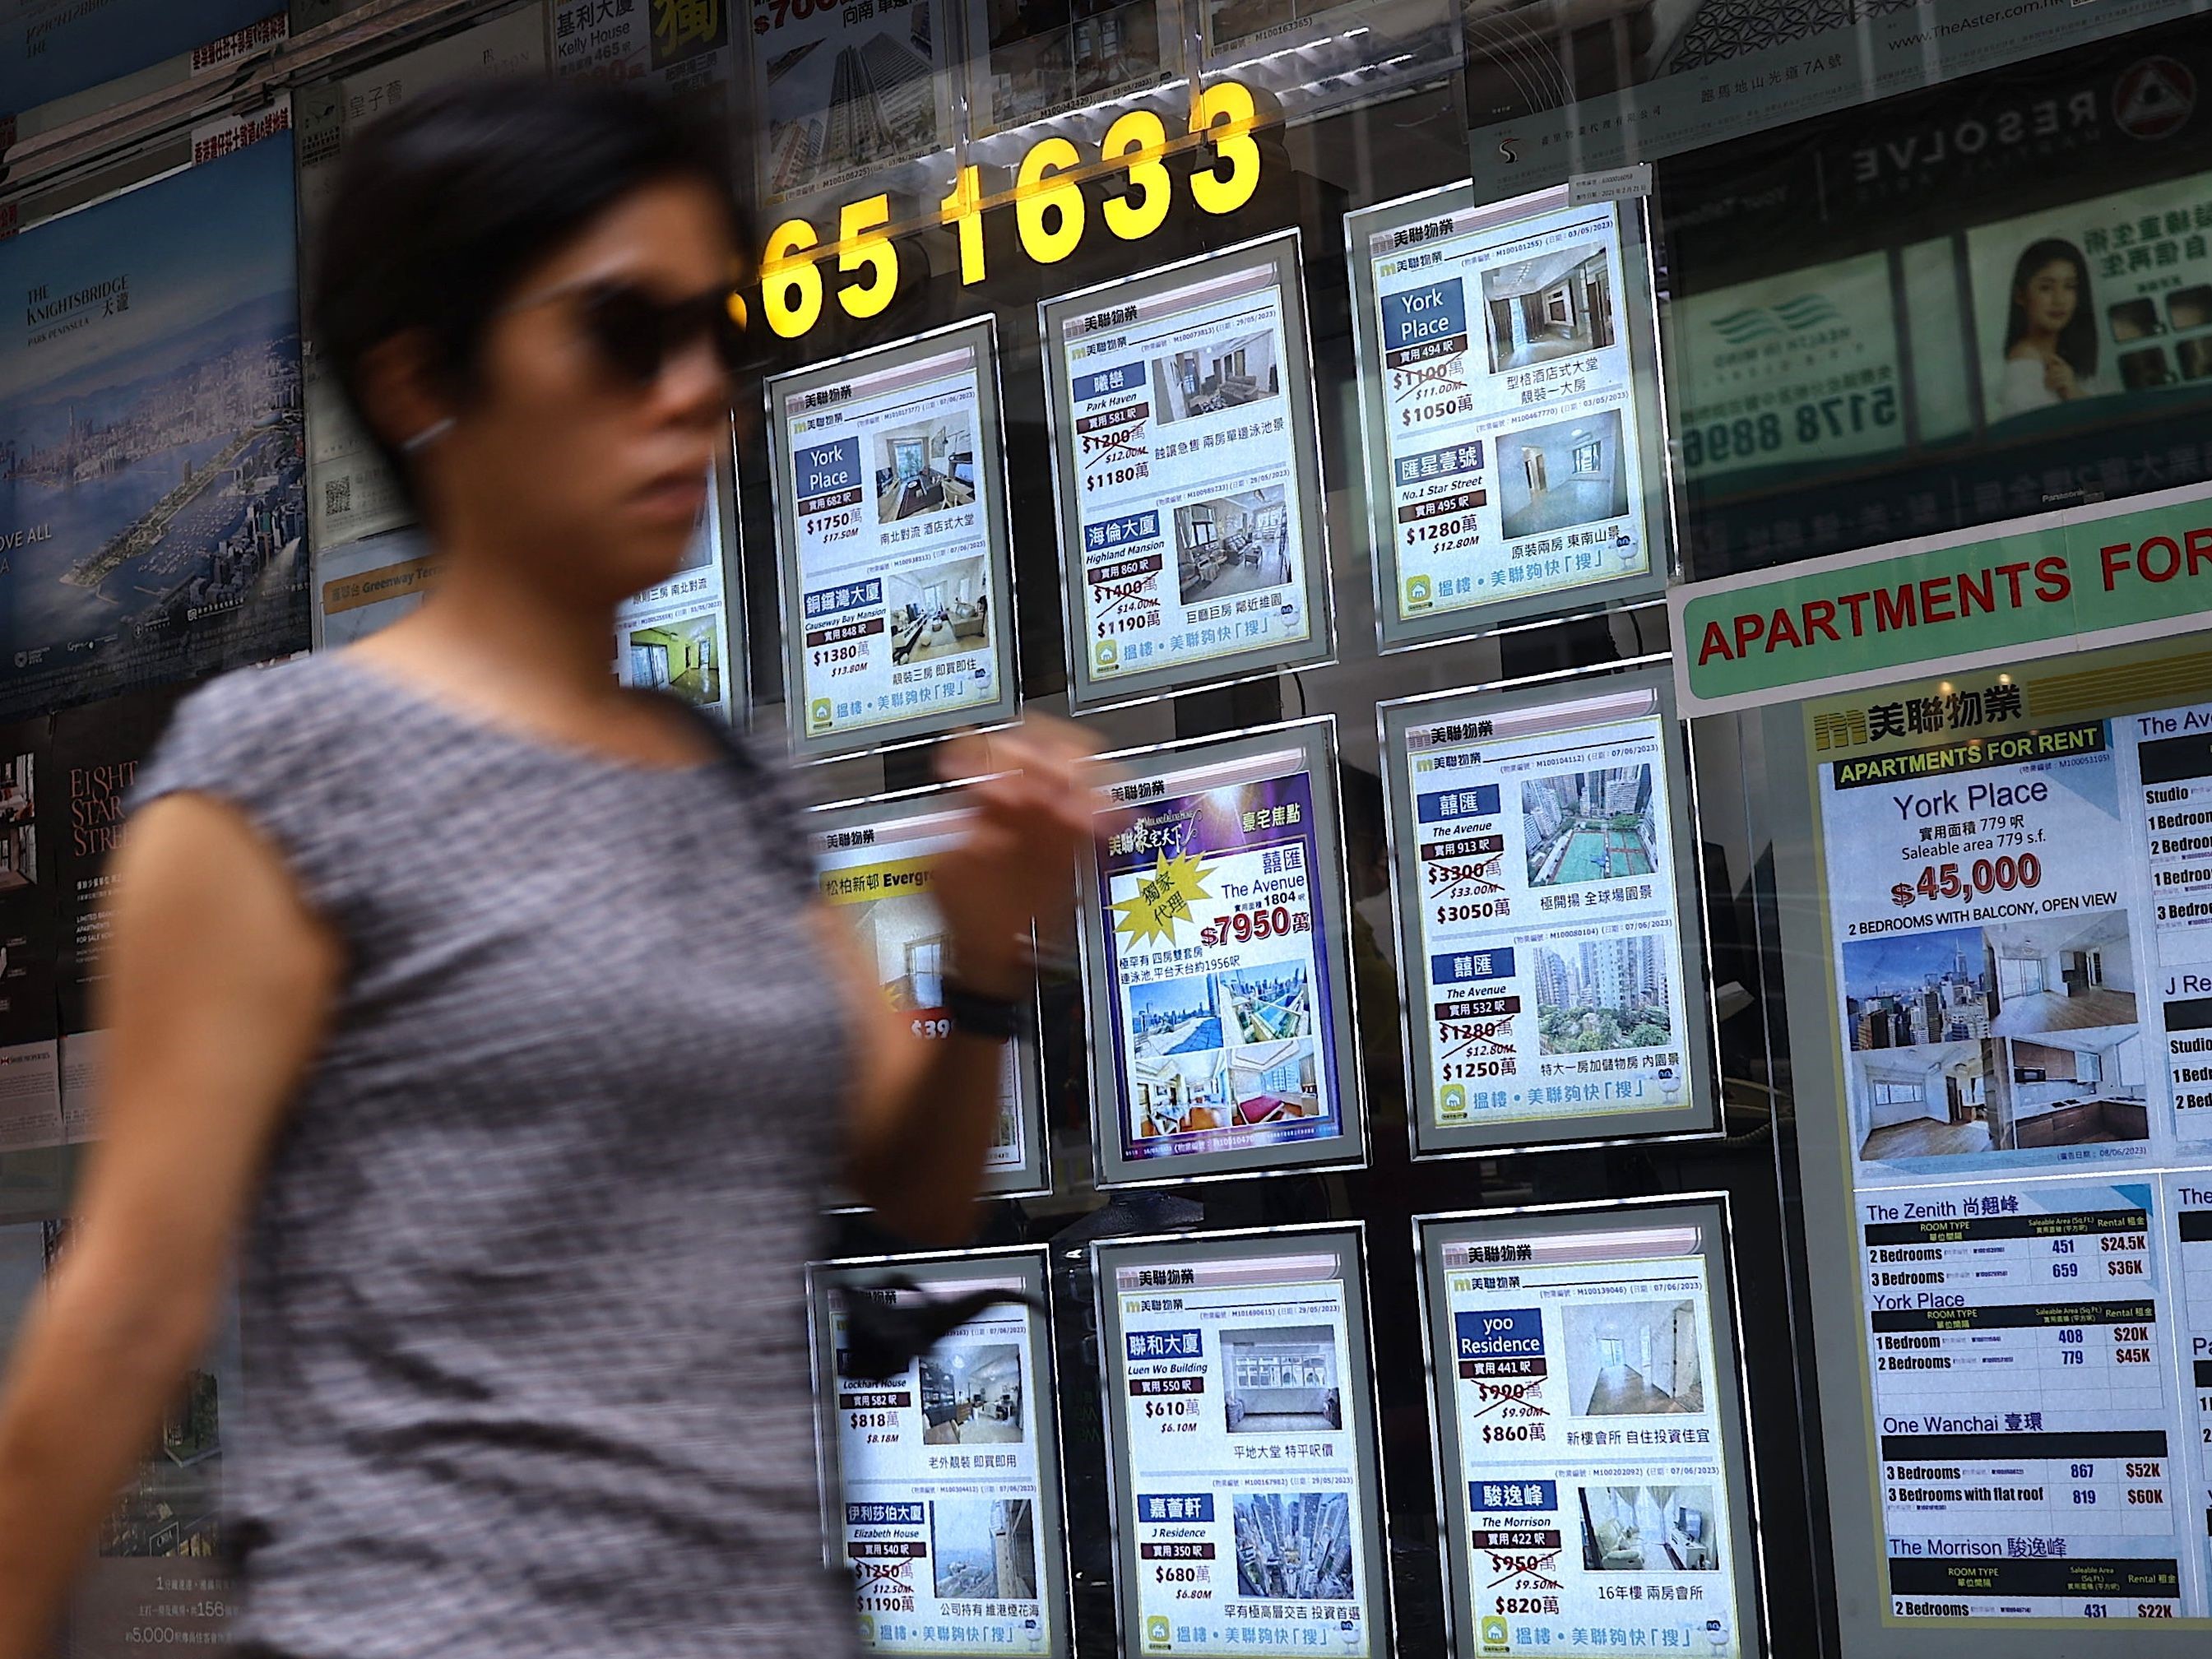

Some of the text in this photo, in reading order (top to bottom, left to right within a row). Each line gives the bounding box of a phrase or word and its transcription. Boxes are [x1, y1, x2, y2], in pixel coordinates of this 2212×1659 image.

[559, 23, 630, 58] Kelly House
[1802, 58, 1824, 77] 7A
[941, 81, 1261, 288] 1633
[26, 274, 130, 326] KNIGHTSBRIDGE
[28, 284, 49, 304] THE
[1401, 288, 1444, 314] York
[1084, 304, 1138, 331] 美聯物業
[1402, 315, 1449, 341] Place
[1421, 344, 1441, 357] 494
[1506, 358, 1598, 390] 型格酒店式大堂
[1087, 392, 1137, 412] Park Haven
[1402, 394, 1473, 426] $1050萬
[811, 445, 843, 466] York
[810, 470, 848, 491] Place
[1087, 461, 1150, 491] $1180萬
[1402, 475, 1482, 501] No.1 Star Street
[807, 508, 862, 535] $1750萬
[924, 513, 975, 535] 酒店式大堂
[1405, 514, 1478, 545] $1280萬
[27, 525, 52, 544] ALL
[823, 527, 859, 544] $17.50M
[1087, 540, 1165, 566] Highland Mansion
[1433, 536, 1479, 555] $12.80M
[363, 572, 413, 594] Greenway
[1698, 529, 2212, 666] APARTMENTS FOR
[1097, 609, 1161, 638] $1190萬
[814, 641, 869, 666] $1380萬
[832, 662, 868, 677] $13.80M
[1867, 684, 2023, 742] 美聯物業
[1431, 721, 1493, 745] 美聯物業
[1840, 727, 2098, 783] APARTMENTS FOR RENT
[1894, 781, 2048, 822] York Place
[2145, 786, 2189, 805] Studio
[72, 795, 126, 829] STAR
[1433, 821, 1492, 838] The Avenue
[1980, 815, 2006, 832] 779
[1901, 832, 2023, 860] Saleable area 779
[1222, 874, 1305, 899] The Avenue
[1890, 852, 2042, 908] $45,000
[1264, 892, 1296, 906] 1804
[1437, 898, 1510, 924] $3050萬
[1859, 892, 2117, 935] BEDROOMS WITH BALCONY, OPEN VIEW
[1200, 906, 1310, 948] $7950萬
[1447, 984, 1506, 1000] The Avenue
[2170, 1037, 2212, 1054] Studio
[1442, 1057, 1516, 1082] $1250萬
[1867, 1205, 1899, 1221] The
[1904, 1201, 1956, 1219] Zenith
[1920, 1221, 1971, 1232] ROOM TYPE
[2098, 1217, 2125, 1228] Rental
[1880, 1235, 2145, 1263] Bedrooms 451 $24.5K
[1882, 1259, 2143, 1286] Bedrooms 659 $36K
[1873, 1291, 1964, 1311] York Place
[1483, 1318, 1514, 1335] yoo
[1461, 1337, 1541, 1355] Residence
[1885, 1327, 2149, 1350] Bedroom 408 $20K
[1128, 1363, 1208, 1375] Luen Wo Building
[1888, 1348, 2150, 1370] Bedrooms 779 $45K
[1145, 1398, 1200, 1419] $610萬
[851, 1412, 901, 1430] $818萬
[1883, 1417, 1919, 1433] One
[1924, 1416, 1999, 1433] Wanchai
[1482, 1421, 1546, 1443] $860萬
[1897, 1462, 2161, 1480] Bedrooms 867 $52K
[1899, 1487, 2163, 1504] Bedrooms with flat roof 819 $60K
[1482, 1516, 1551, 1527] The Morrison
[854, 1528, 920, 1539] Elizabeth House
[1159, 1528, 1206, 1538] Residence
[1890, 1537, 2067, 1558] The Morrison 駿逸峰
[1155, 1564, 1211, 1584] $680萬
[1496, 1595, 1560, 1615] $820萬
[1905, 1601, 2173, 1619] Bedrooms 431 $22K
